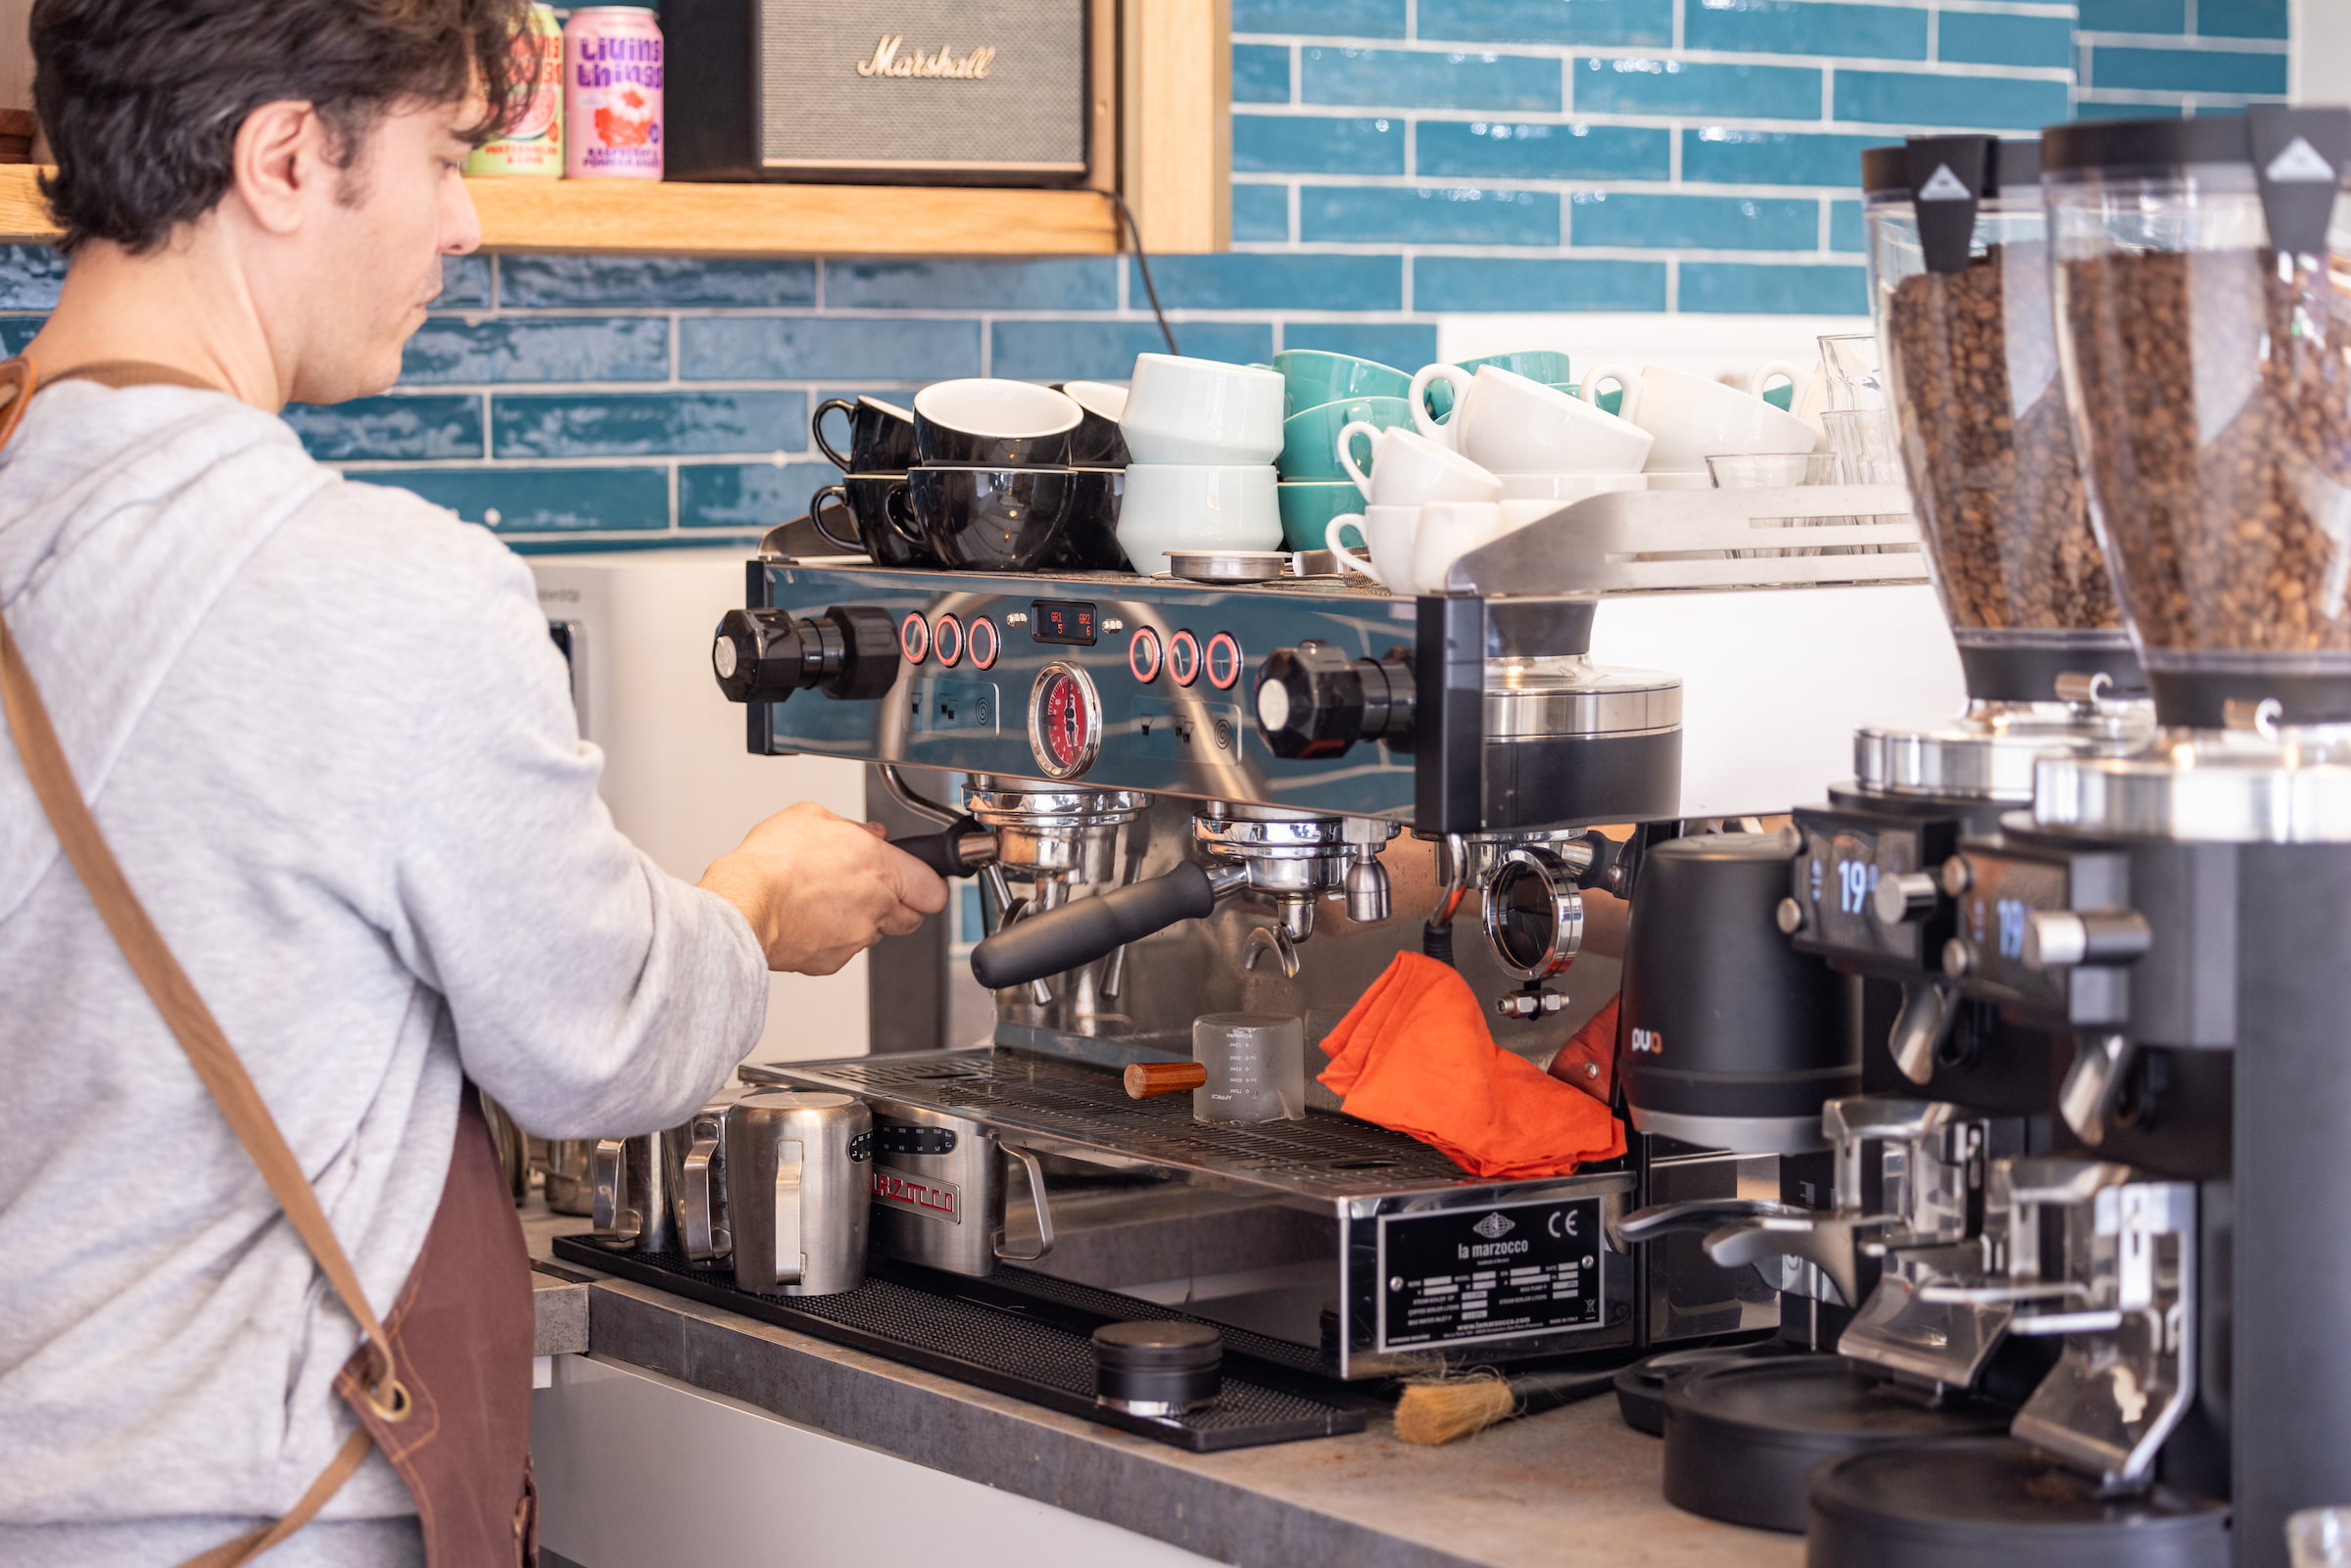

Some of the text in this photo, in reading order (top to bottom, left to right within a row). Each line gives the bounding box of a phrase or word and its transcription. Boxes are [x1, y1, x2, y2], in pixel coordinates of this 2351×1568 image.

[856, 33, 996, 79] Marshall
[1050, 611, 1091, 625] GR1 GR2
[1057, 623, 1091, 637] 5 6
[1838, 860, 1866, 914] 19
[1458, 1240, 1528, 1259] la marzocco
[1457, 1316, 1531, 1331] www.lamarzocco.com
